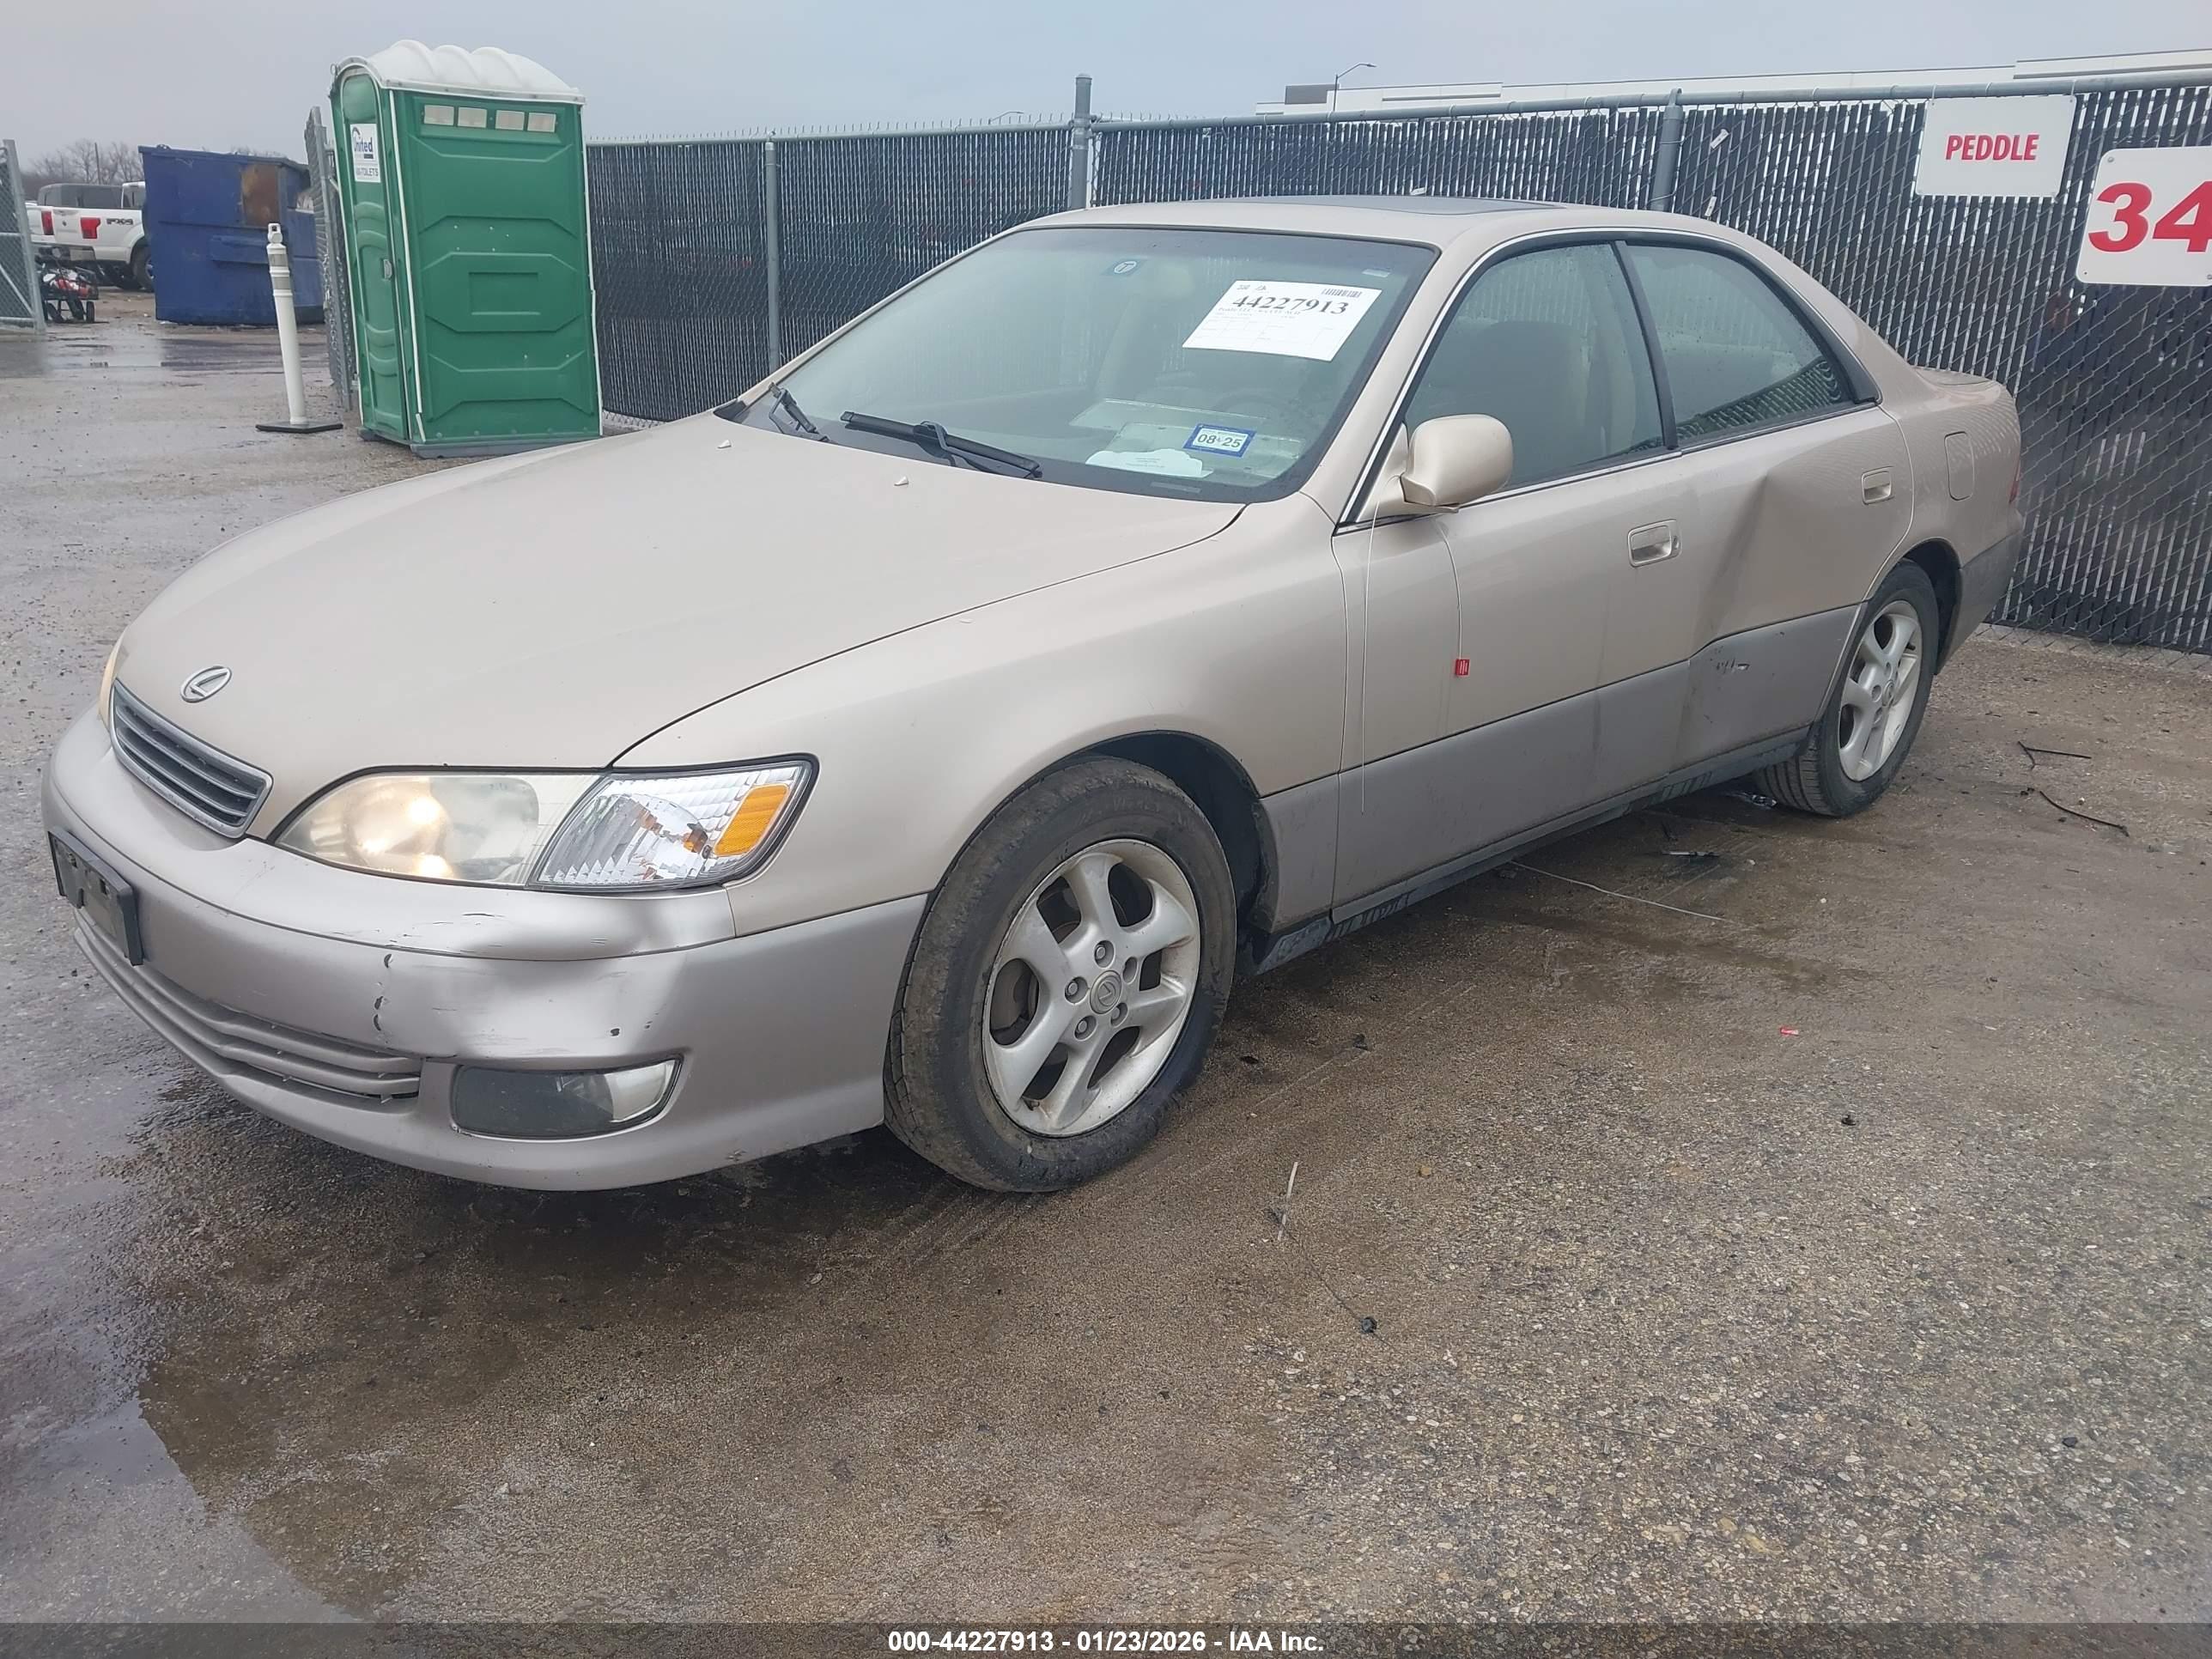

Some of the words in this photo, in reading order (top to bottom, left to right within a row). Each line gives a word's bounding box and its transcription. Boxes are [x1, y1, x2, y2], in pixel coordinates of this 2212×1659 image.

[1945, 134, 2040, 161] PEDDLE
[2087, 179, 2212, 252] 34
[1232, 295, 1350, 315] 44227913
[1197, 434, 1217, 444] 08
[1221, 437, 1243, 448] 25
